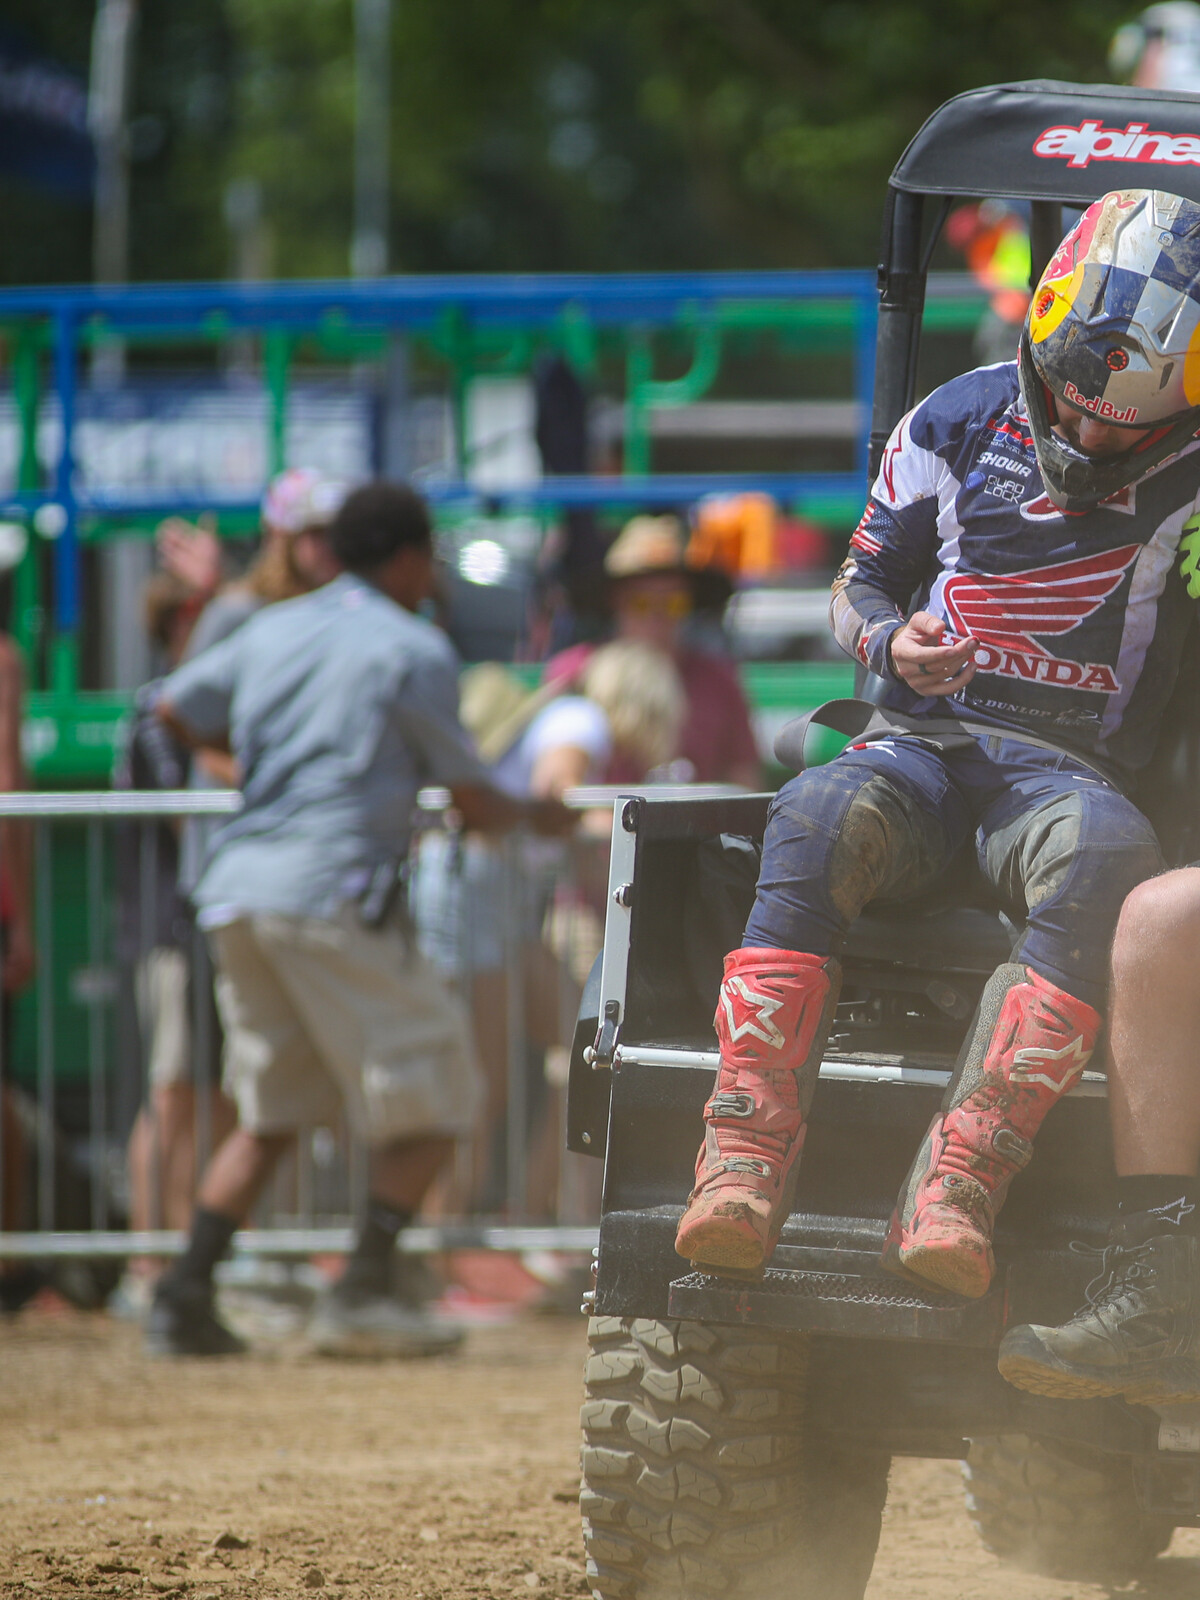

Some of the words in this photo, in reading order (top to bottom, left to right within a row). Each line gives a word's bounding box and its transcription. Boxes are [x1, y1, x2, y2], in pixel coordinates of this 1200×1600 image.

[1063, 380, 1099, 412] Red
[1096, 400, 1139, 423] Bull
[976, 451, 1033, 477] SHOWA
[983, 484, 1021, 504] LOCK
[987, 474, 1025, 495] QUAD
[985, 699, 1052, 718] DUNLOP
